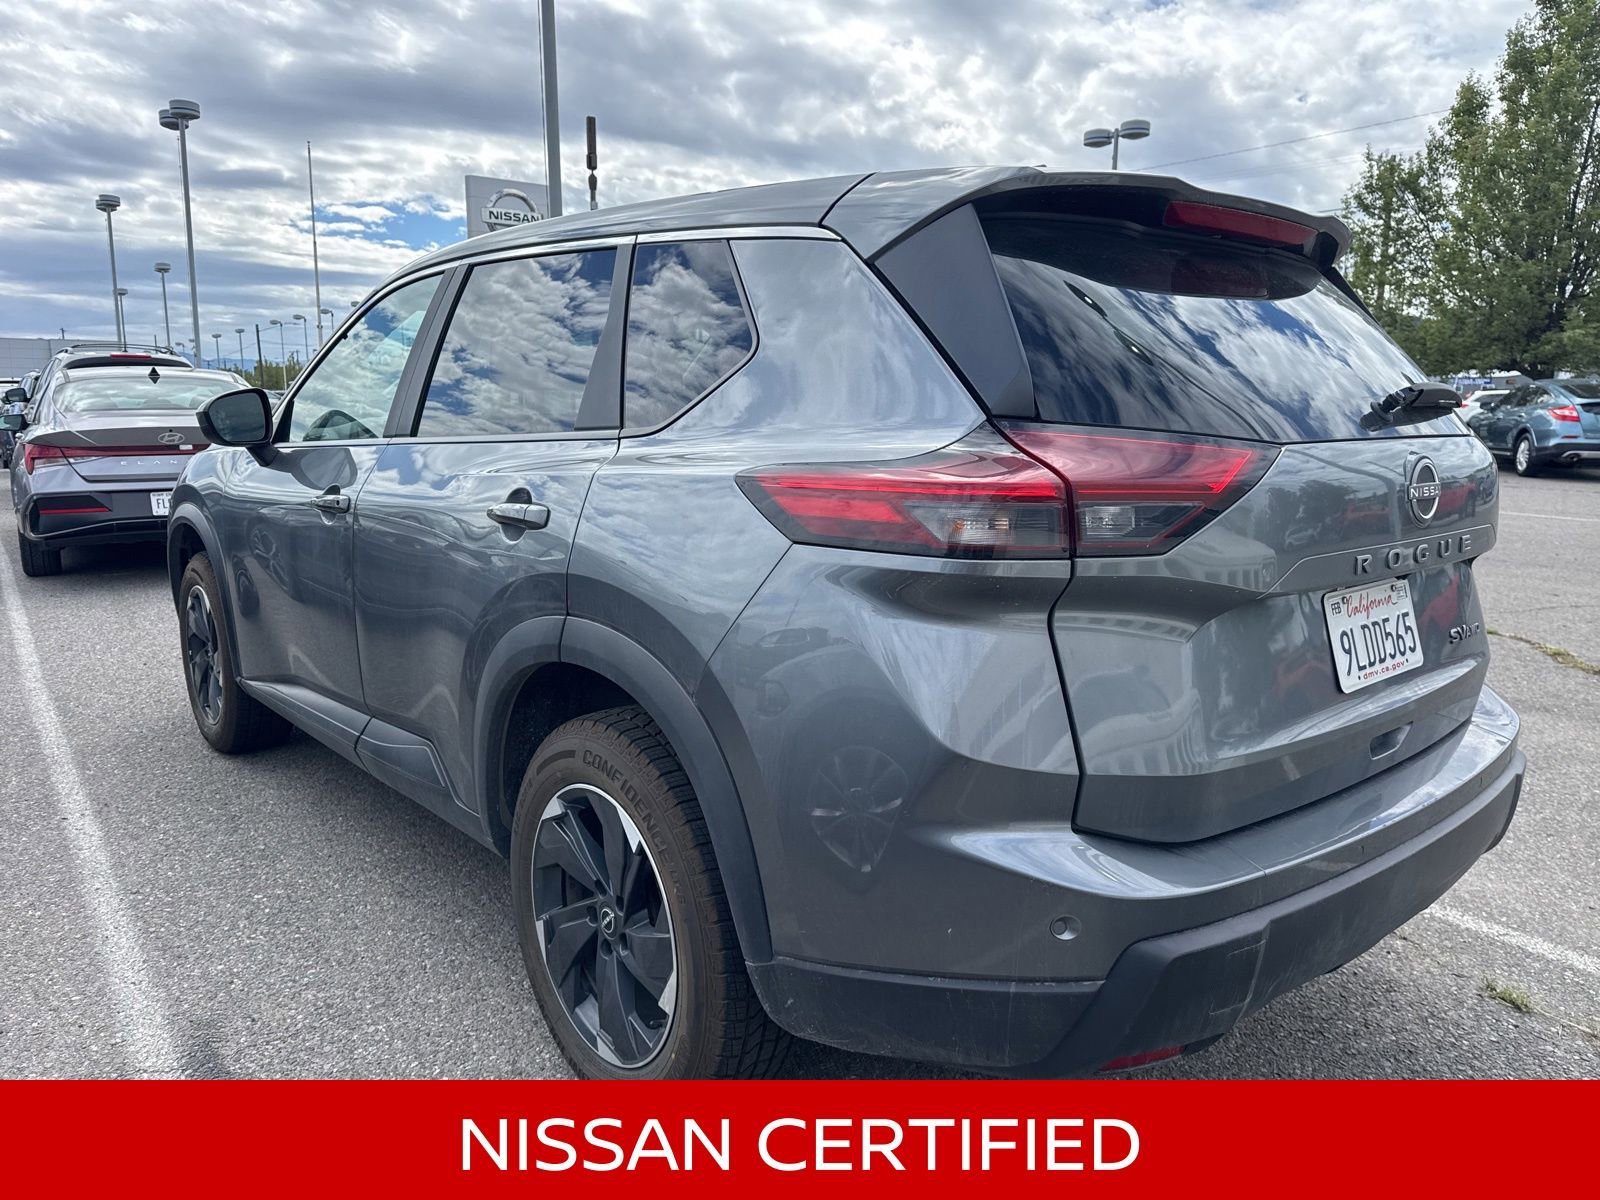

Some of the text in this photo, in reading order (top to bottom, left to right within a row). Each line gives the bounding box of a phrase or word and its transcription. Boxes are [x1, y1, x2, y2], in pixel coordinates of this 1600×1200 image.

[488, 210, 539, 223] NISSAN
[156, 498, 171, 509] FL
[1354, 534, 1472, 576] ROGUE
[1331, 602, 1342, 616] FEB
[1345, 592, 1398, 619] California
[1340, 611, 1417, 676] 9LDD565
[1363, 660, 1405, 680] dmv.ca.gov
